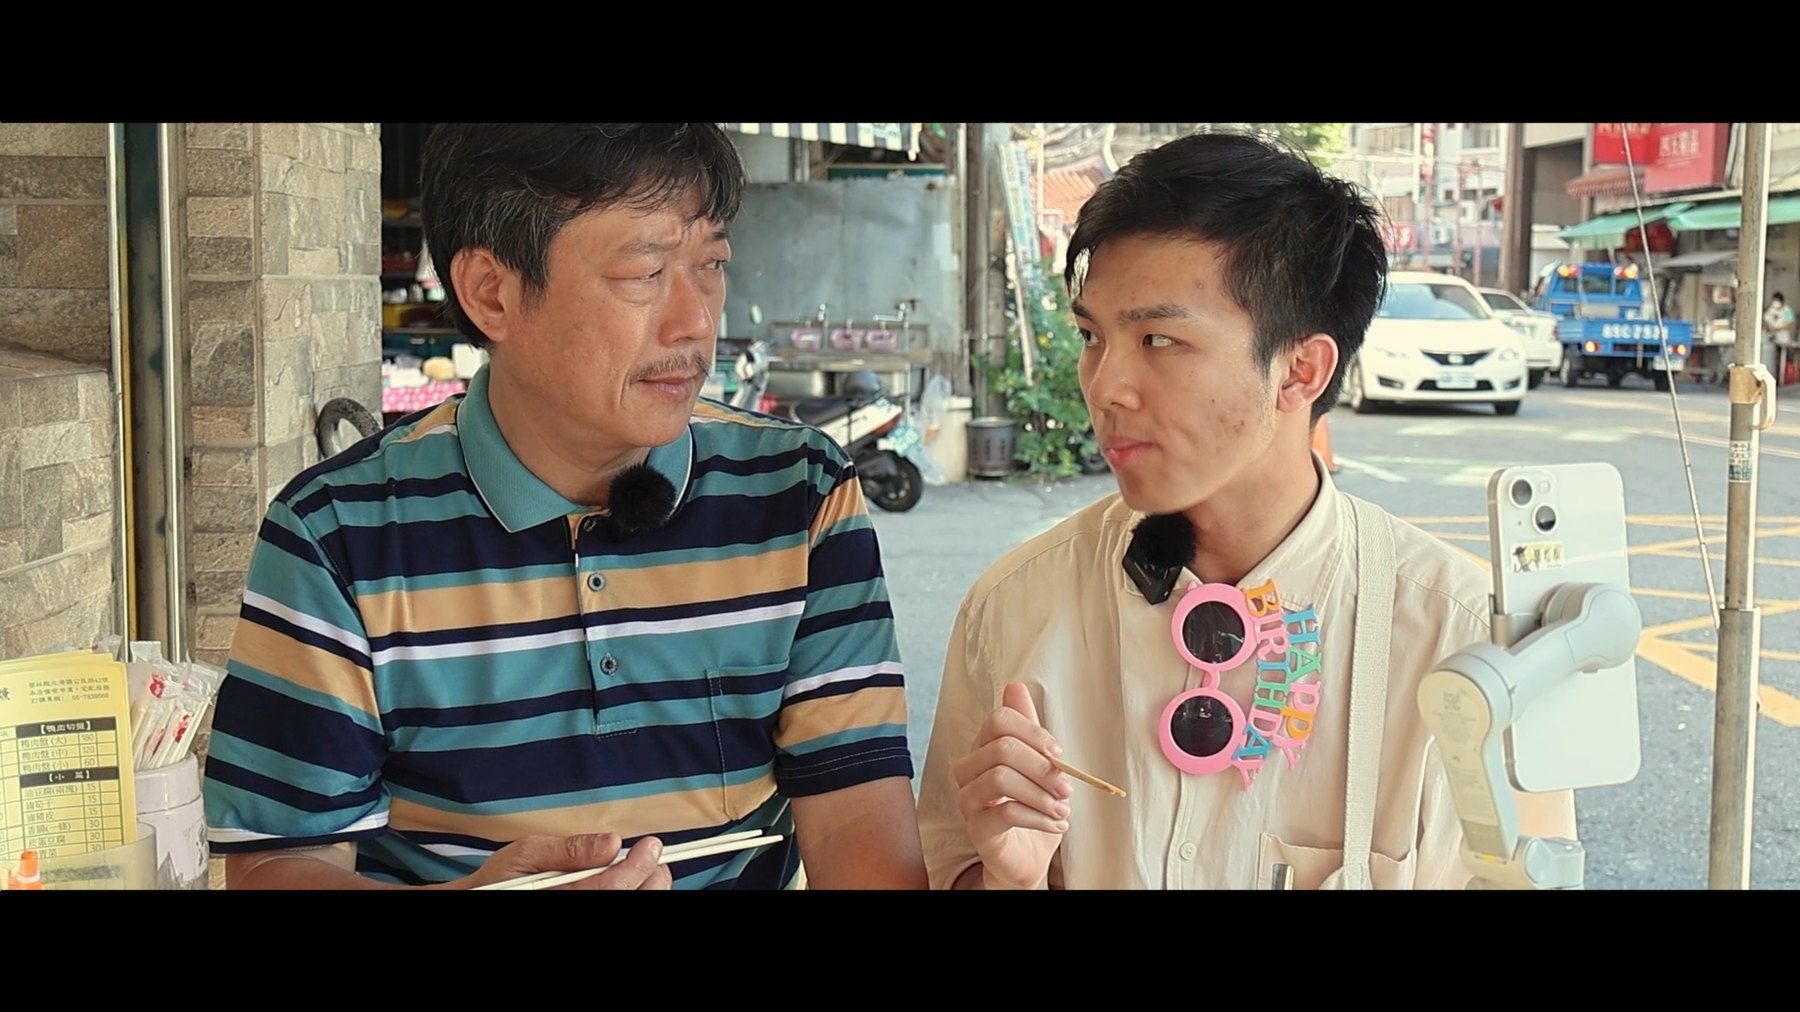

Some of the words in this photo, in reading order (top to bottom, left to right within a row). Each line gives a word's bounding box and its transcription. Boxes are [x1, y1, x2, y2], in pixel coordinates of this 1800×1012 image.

[1231, 577, 1292, 791] BIRTHDAY
[1273, 603, 1322, 770] HAPPY
[84, 758, 96, 767] 60
[87, 783, 96, 791] 15
[88, 795, 97, 803] 15
[89, 807, 98, 816] 15
[89, 819, 100, 828] 30
[90, 831, 100, 840] 30
